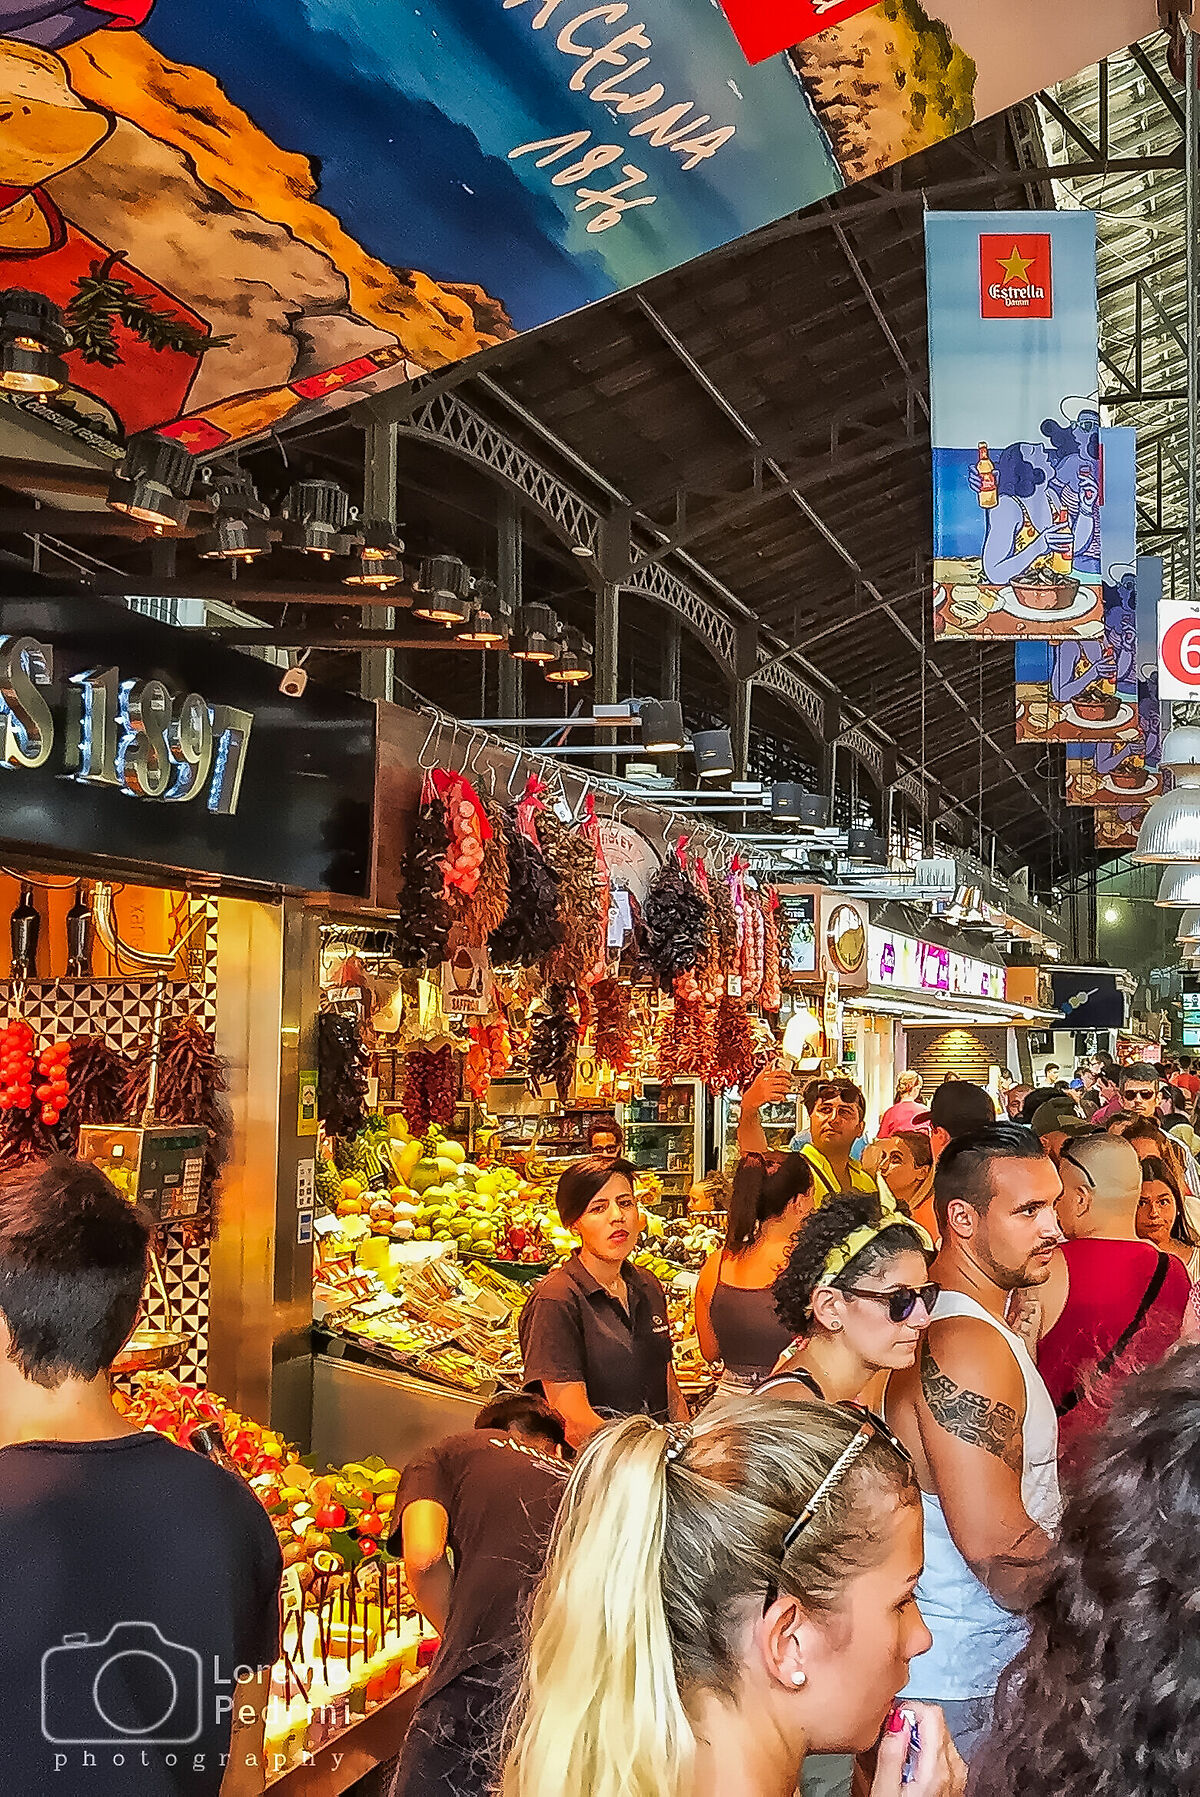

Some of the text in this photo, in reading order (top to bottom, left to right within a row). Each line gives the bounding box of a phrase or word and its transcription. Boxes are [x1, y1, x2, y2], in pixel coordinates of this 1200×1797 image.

[507, 130, 658, 233] 1876
[988, 283, 1045, 299] Estrella
[58, 665, 254, 815] 1897
